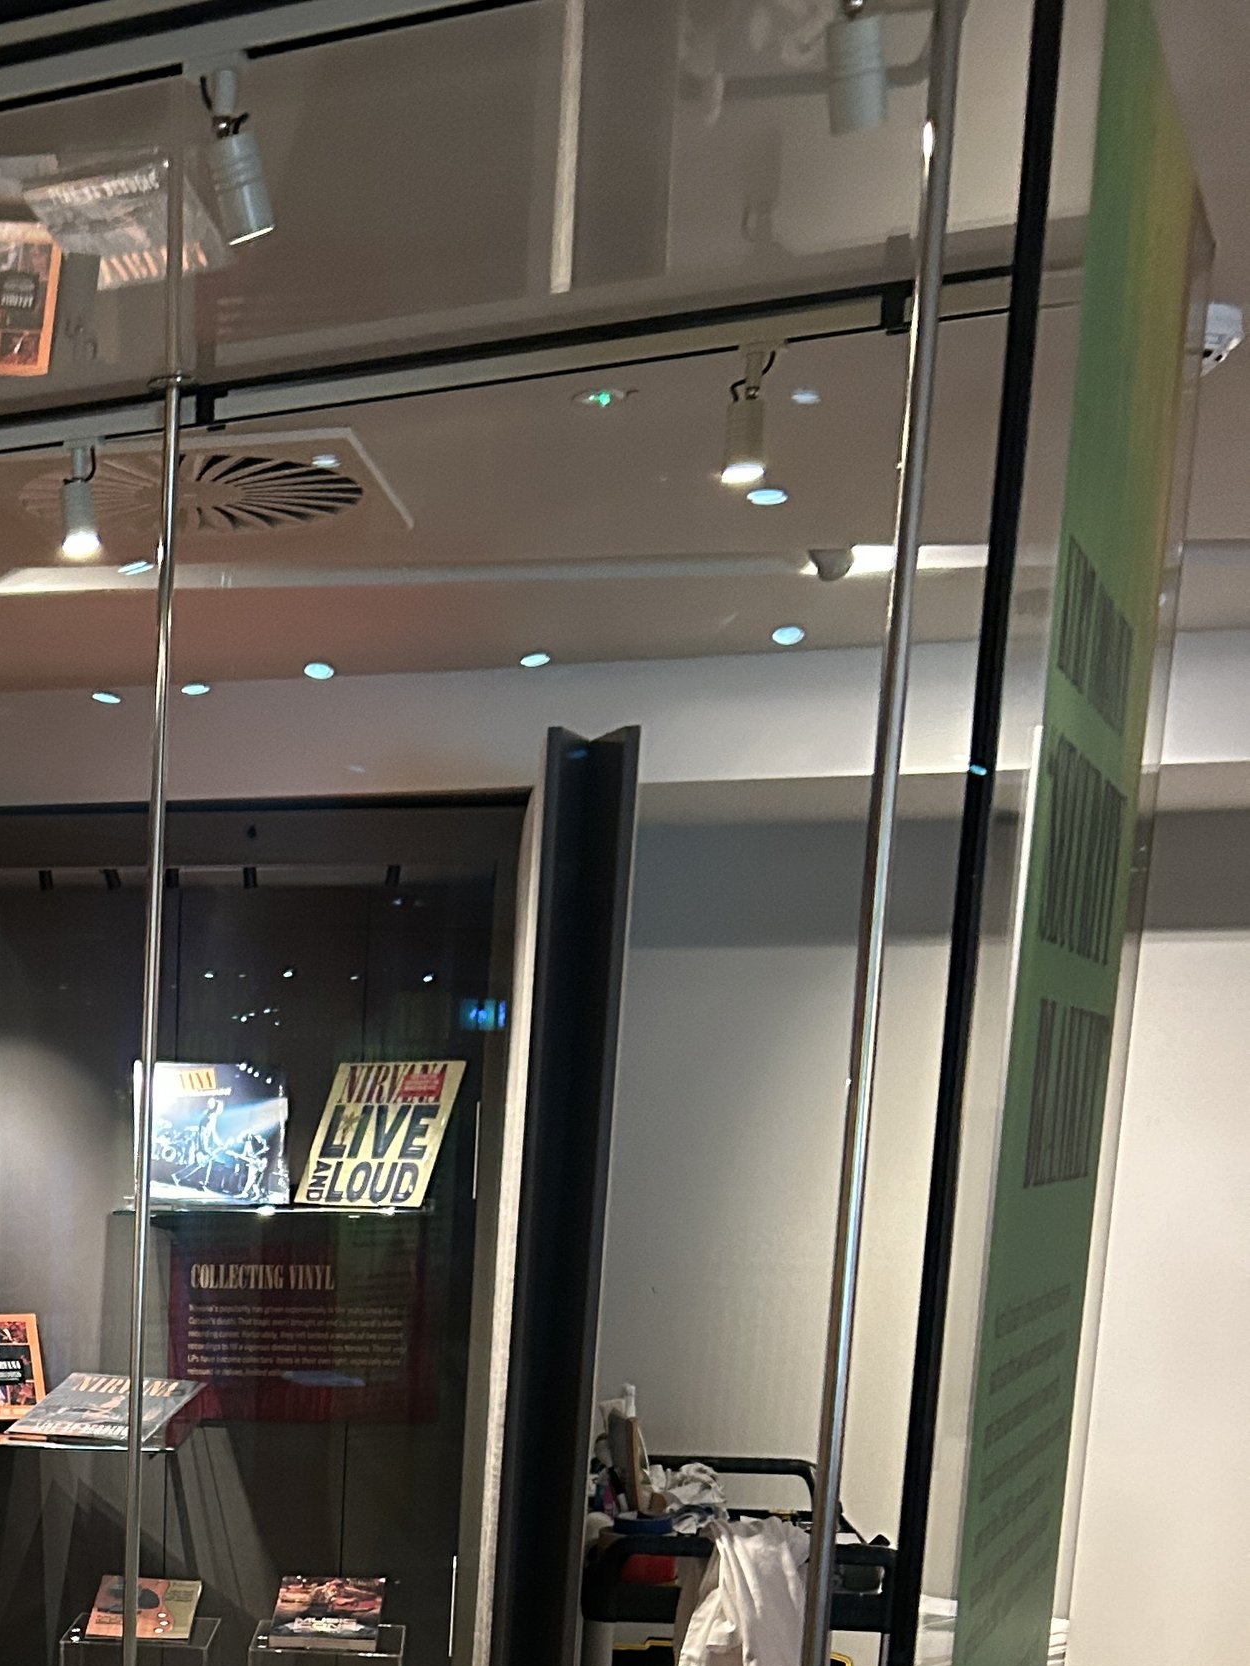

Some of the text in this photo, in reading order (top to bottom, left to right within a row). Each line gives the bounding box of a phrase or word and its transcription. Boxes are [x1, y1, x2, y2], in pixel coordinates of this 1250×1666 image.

[318, 1104, 440, 1160] LIVE
[307, 1160, 332, 1202] AND
[325, 1161, 419, 1204] LOUD
[191, 1264, 335, 1290] COLLECTING VINYL
[73, 1376, 179, 1397] NIRVNA
